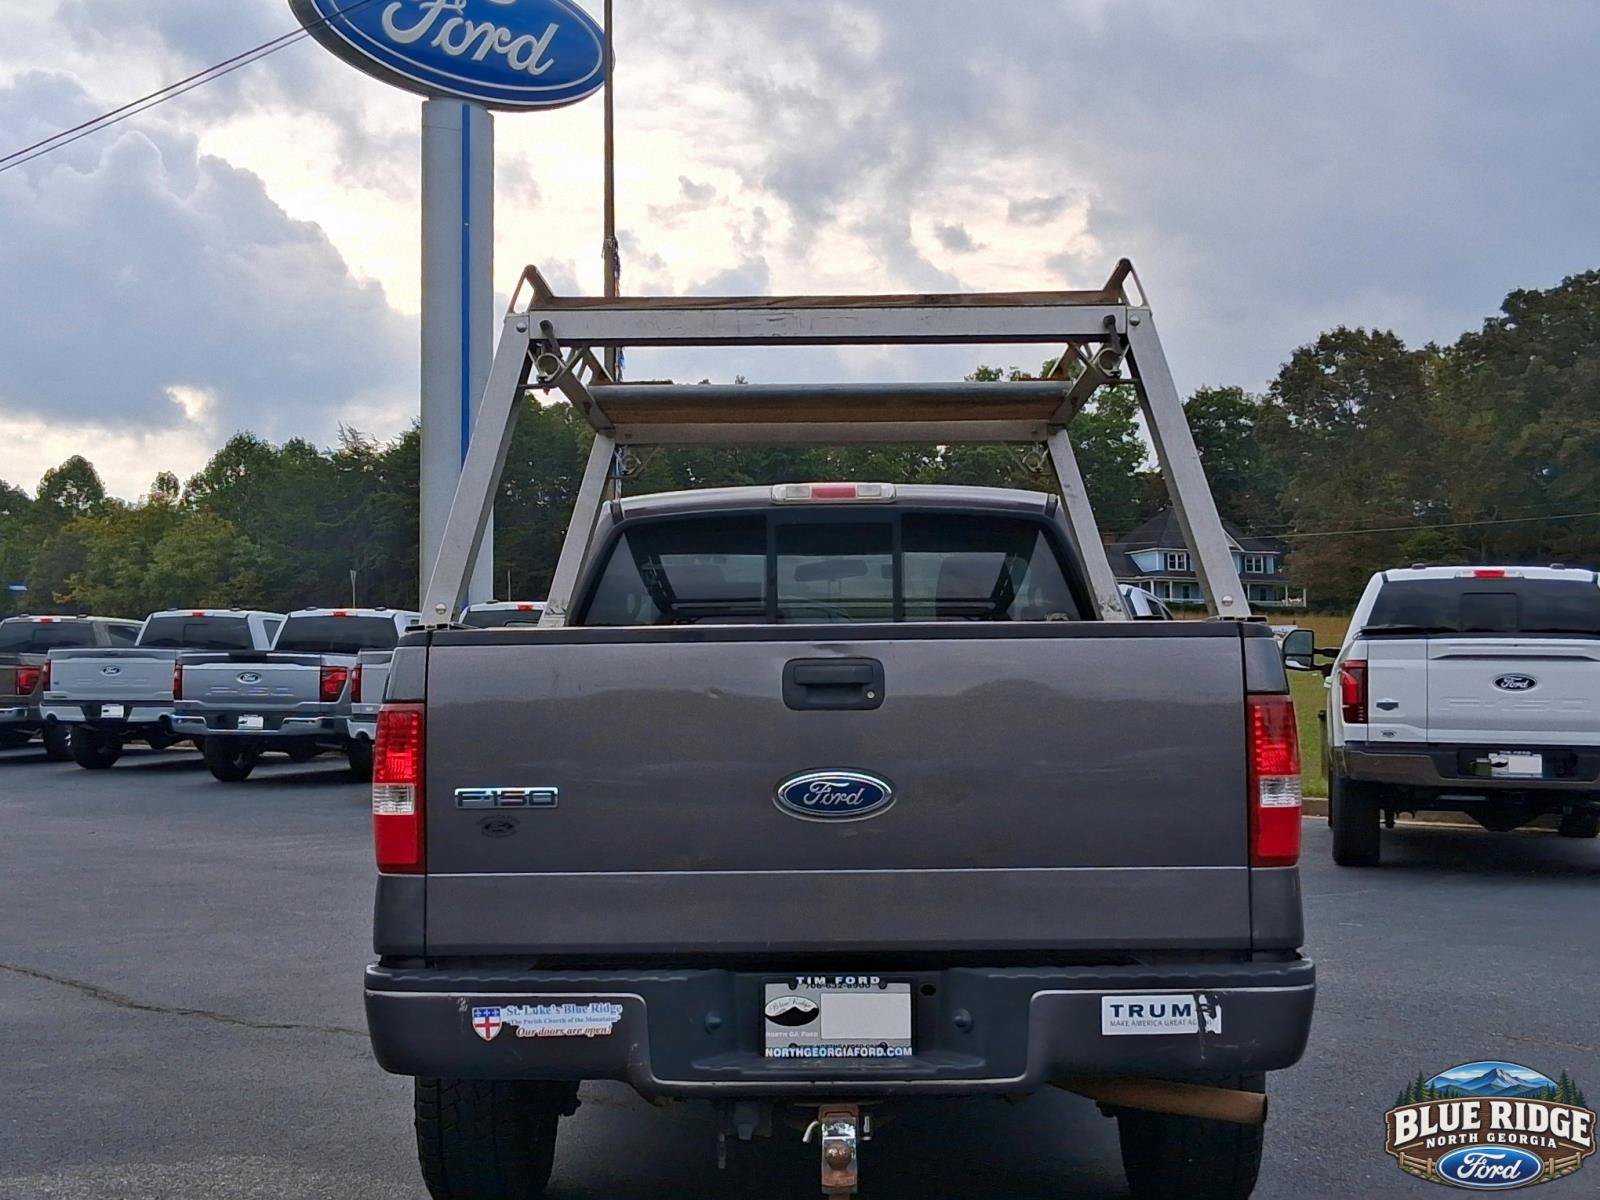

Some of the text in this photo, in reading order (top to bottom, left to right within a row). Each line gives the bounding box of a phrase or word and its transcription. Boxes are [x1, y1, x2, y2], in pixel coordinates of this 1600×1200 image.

[381, 0, 560, 77] Ford
[1501, 676, 1529, 688] Ford
[803, 781, 865, 805] Ford
[796, 976, 880, 984] TIM FORD
[506, 1003, 622, 1016] St. Luke's Blue Ridge
[1131, 1019, 1162, 1027] AMERICA
[518, 1025, 612, 1037] Our doors are open!
[765, 1047, 912, 1057] NORTHGEORGIAFORD.COM
